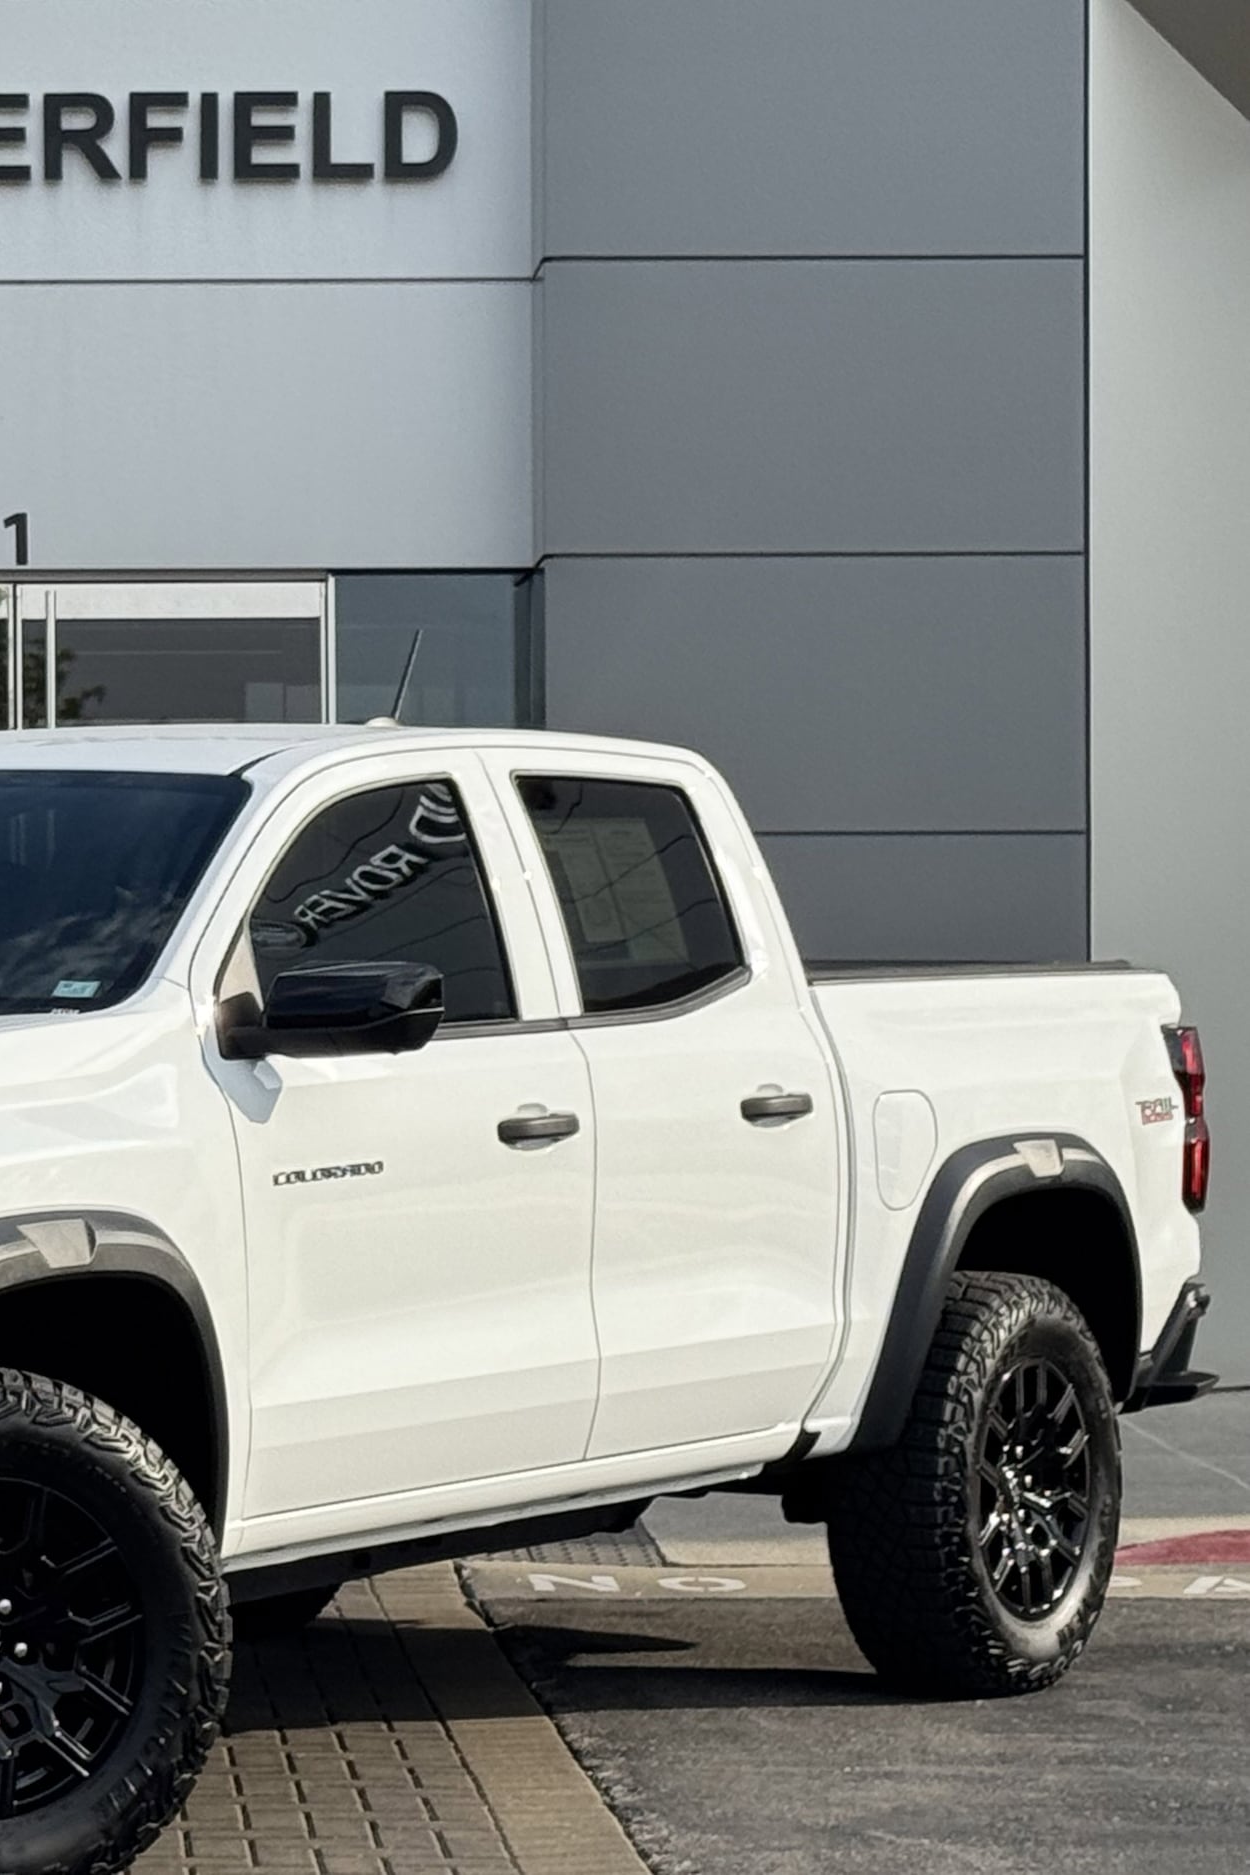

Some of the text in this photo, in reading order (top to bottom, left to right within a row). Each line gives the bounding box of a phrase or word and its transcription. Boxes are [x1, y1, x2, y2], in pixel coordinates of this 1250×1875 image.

[3, 512, 27, 566] 1
[273, 1161, 384, 1186] COLORADO
[528, 1573, 747, 1593] NO
